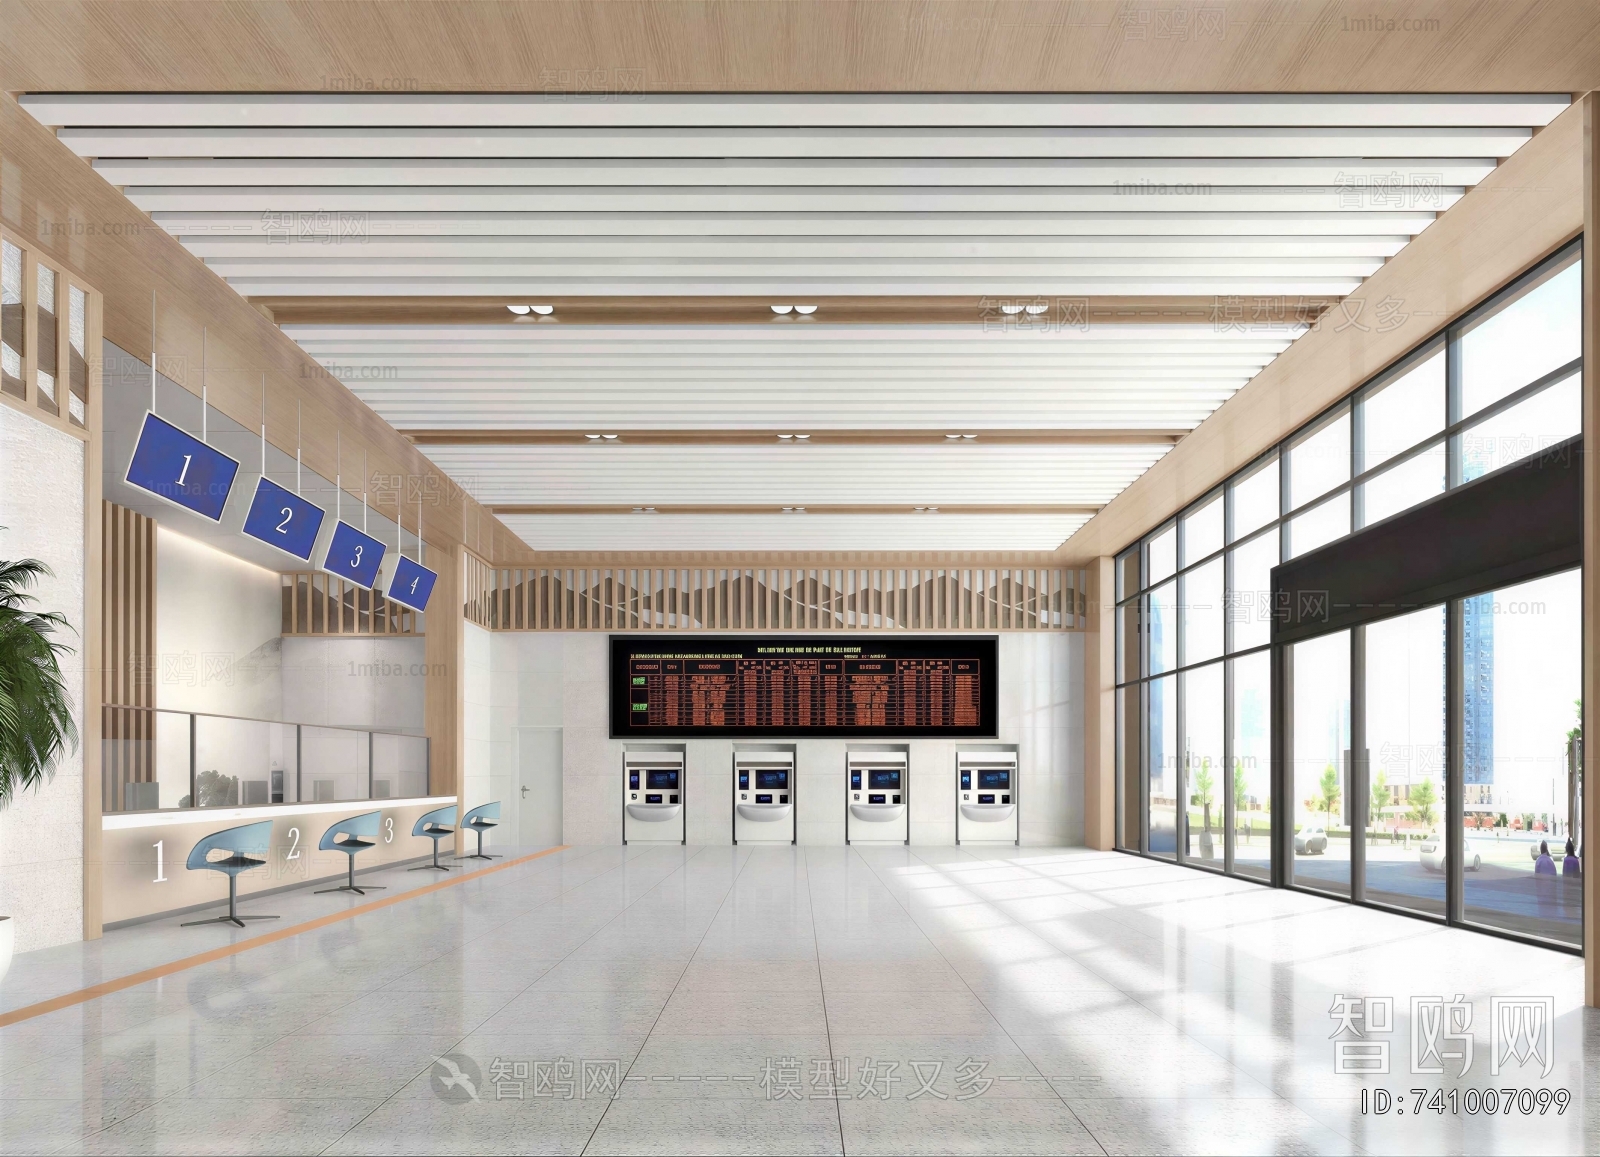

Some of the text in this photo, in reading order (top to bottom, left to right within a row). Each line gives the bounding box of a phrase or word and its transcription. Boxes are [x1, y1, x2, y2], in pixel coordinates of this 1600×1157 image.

[175, 455, 191, 486] 1
[276, 508, 292, 533] 2
[351, 546, 362, 567] 3
[411, 577, 419, 594] 4
[287, 827, 301, 860] 2
[384, 817, 395, 844] 3
[152, 840, 168, 883] 1
